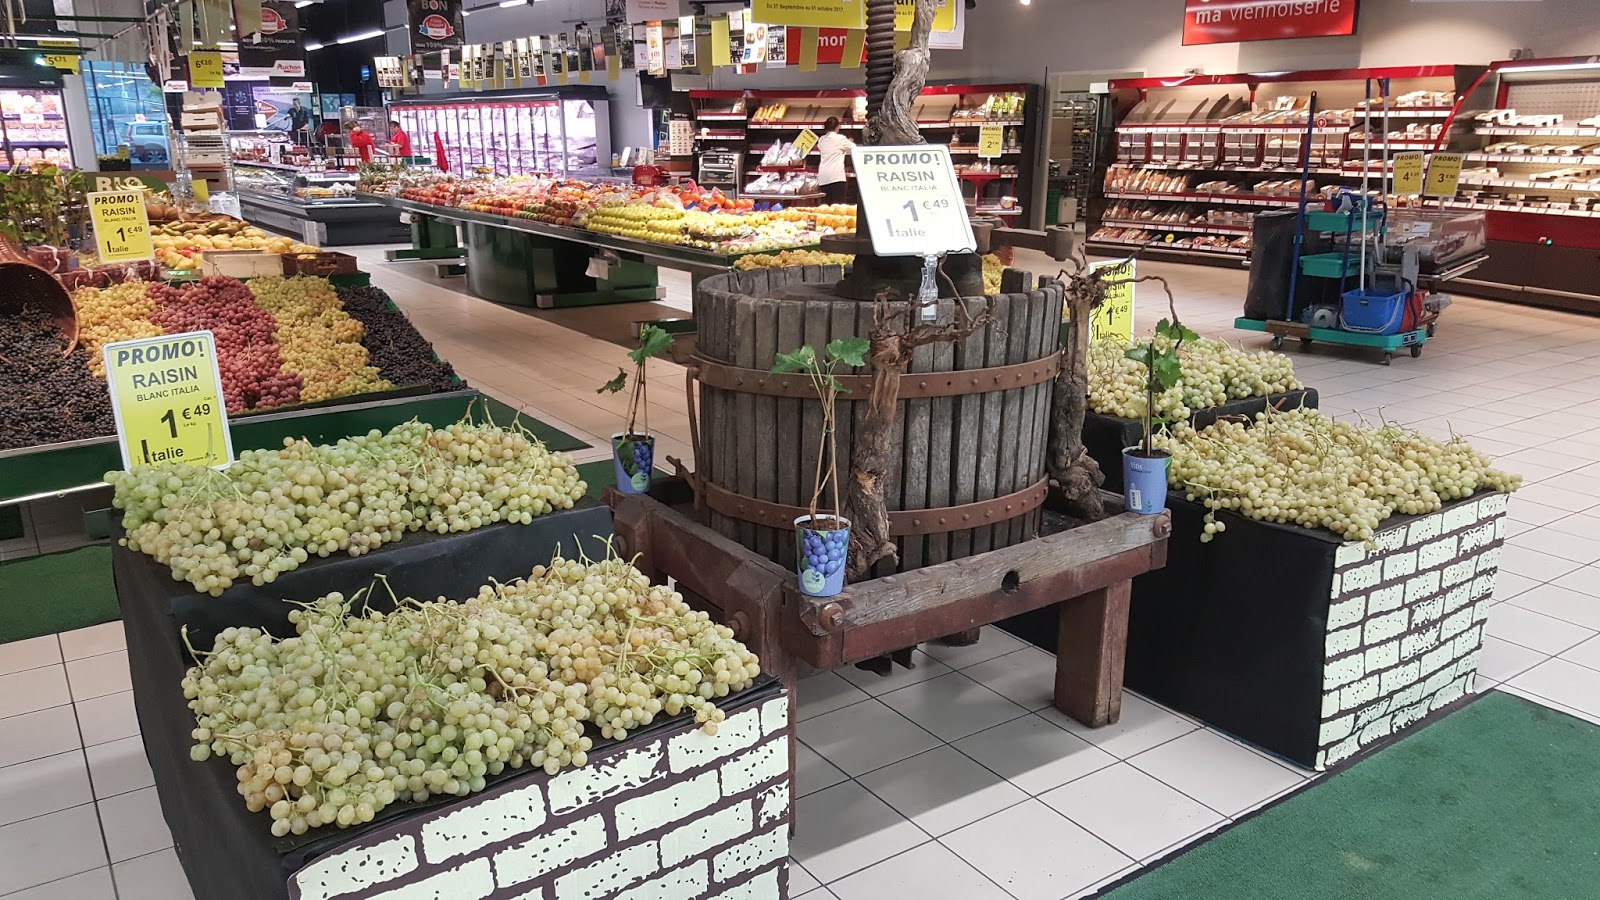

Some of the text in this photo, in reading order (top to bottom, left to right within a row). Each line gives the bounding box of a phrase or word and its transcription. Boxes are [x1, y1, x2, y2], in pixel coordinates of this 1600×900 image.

[422, 0, 448, 10] BON
[1196, 0, 1340, 24] ma viennoiserie
[864, 153, 940, 165] PROMO!
[876, 171, 934, 182] RAISIN
[94, 194, 139, 205] PROMO!
[102, 207, 136, 216] RAISIN
[886, 219, 925, 237] Italie
[107, 240, 128, 253] Italie
[117, 340, 204, 367] PROMO!
[132, 366, 198, 389] RAISIN
[136, 385, 200, 402] BLANC ITALIA
[141, 439, 184, 463] Italie
